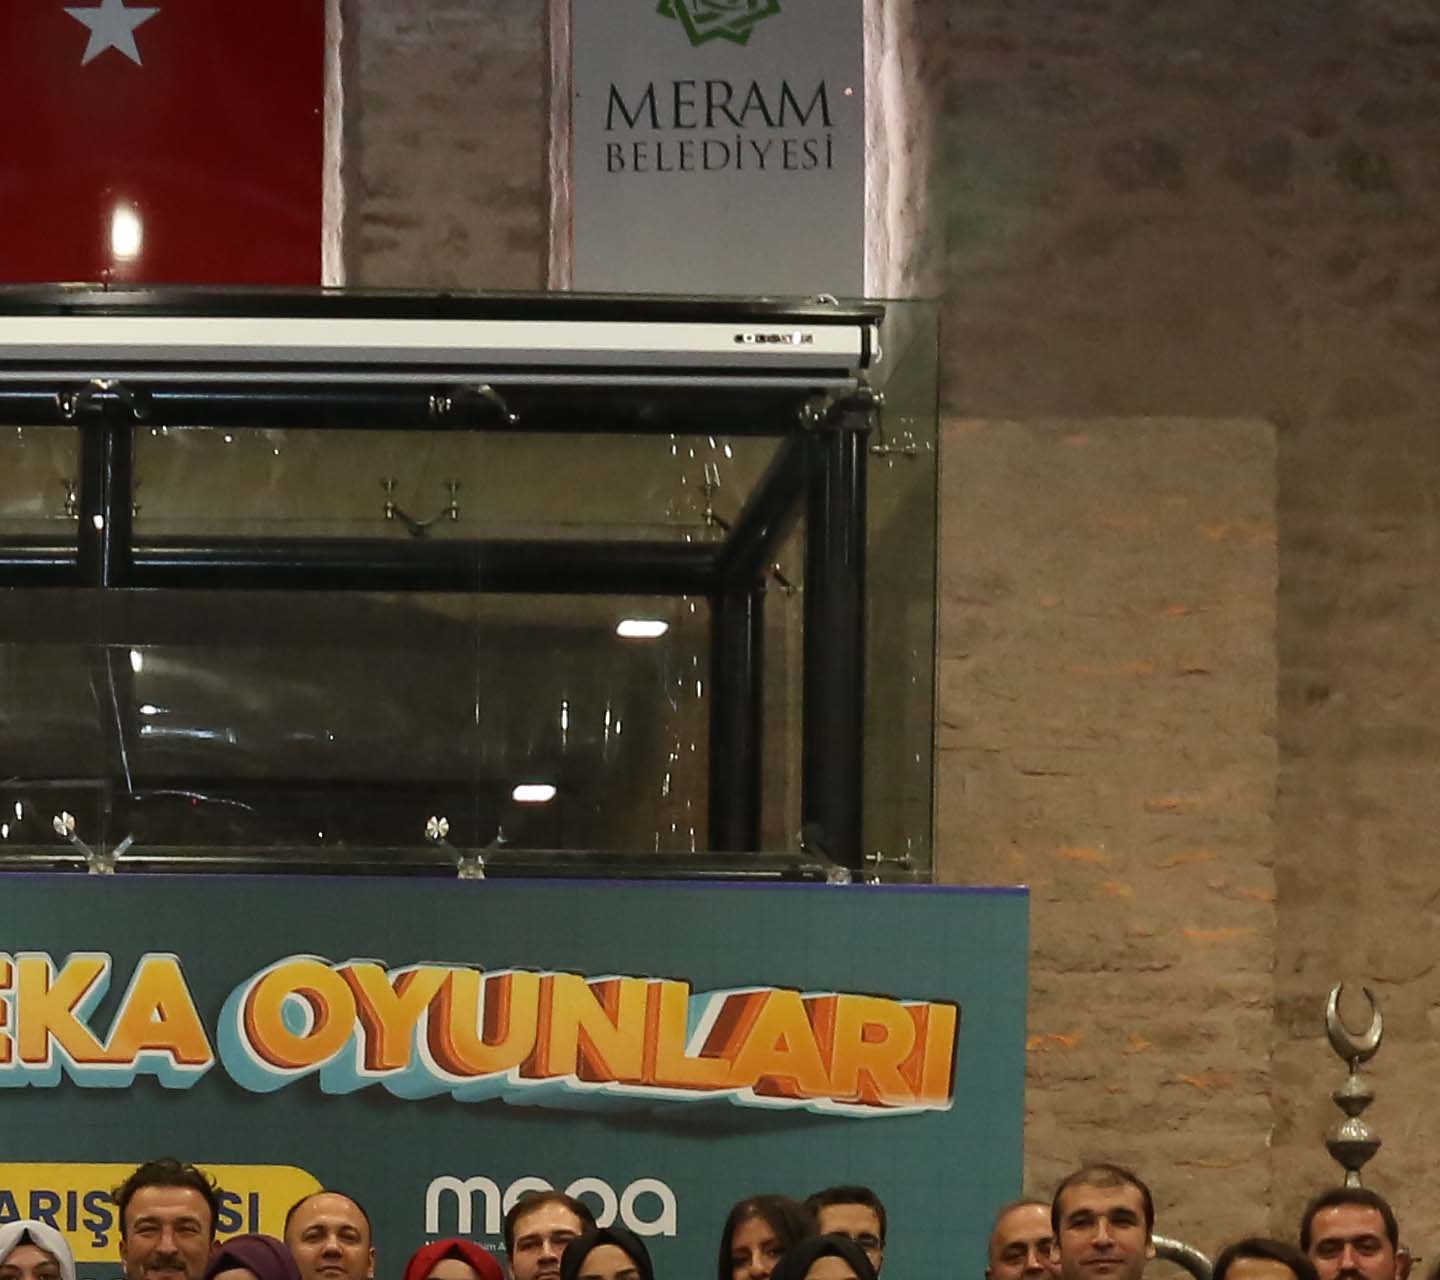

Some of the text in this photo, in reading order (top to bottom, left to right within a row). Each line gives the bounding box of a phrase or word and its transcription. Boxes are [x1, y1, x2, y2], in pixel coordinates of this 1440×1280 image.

[605, 79, 834, 130] MERAM
[606, 133, 834, 173] BELEDİYESİ
[238, 957, 960, 1108] OYUNLARI
